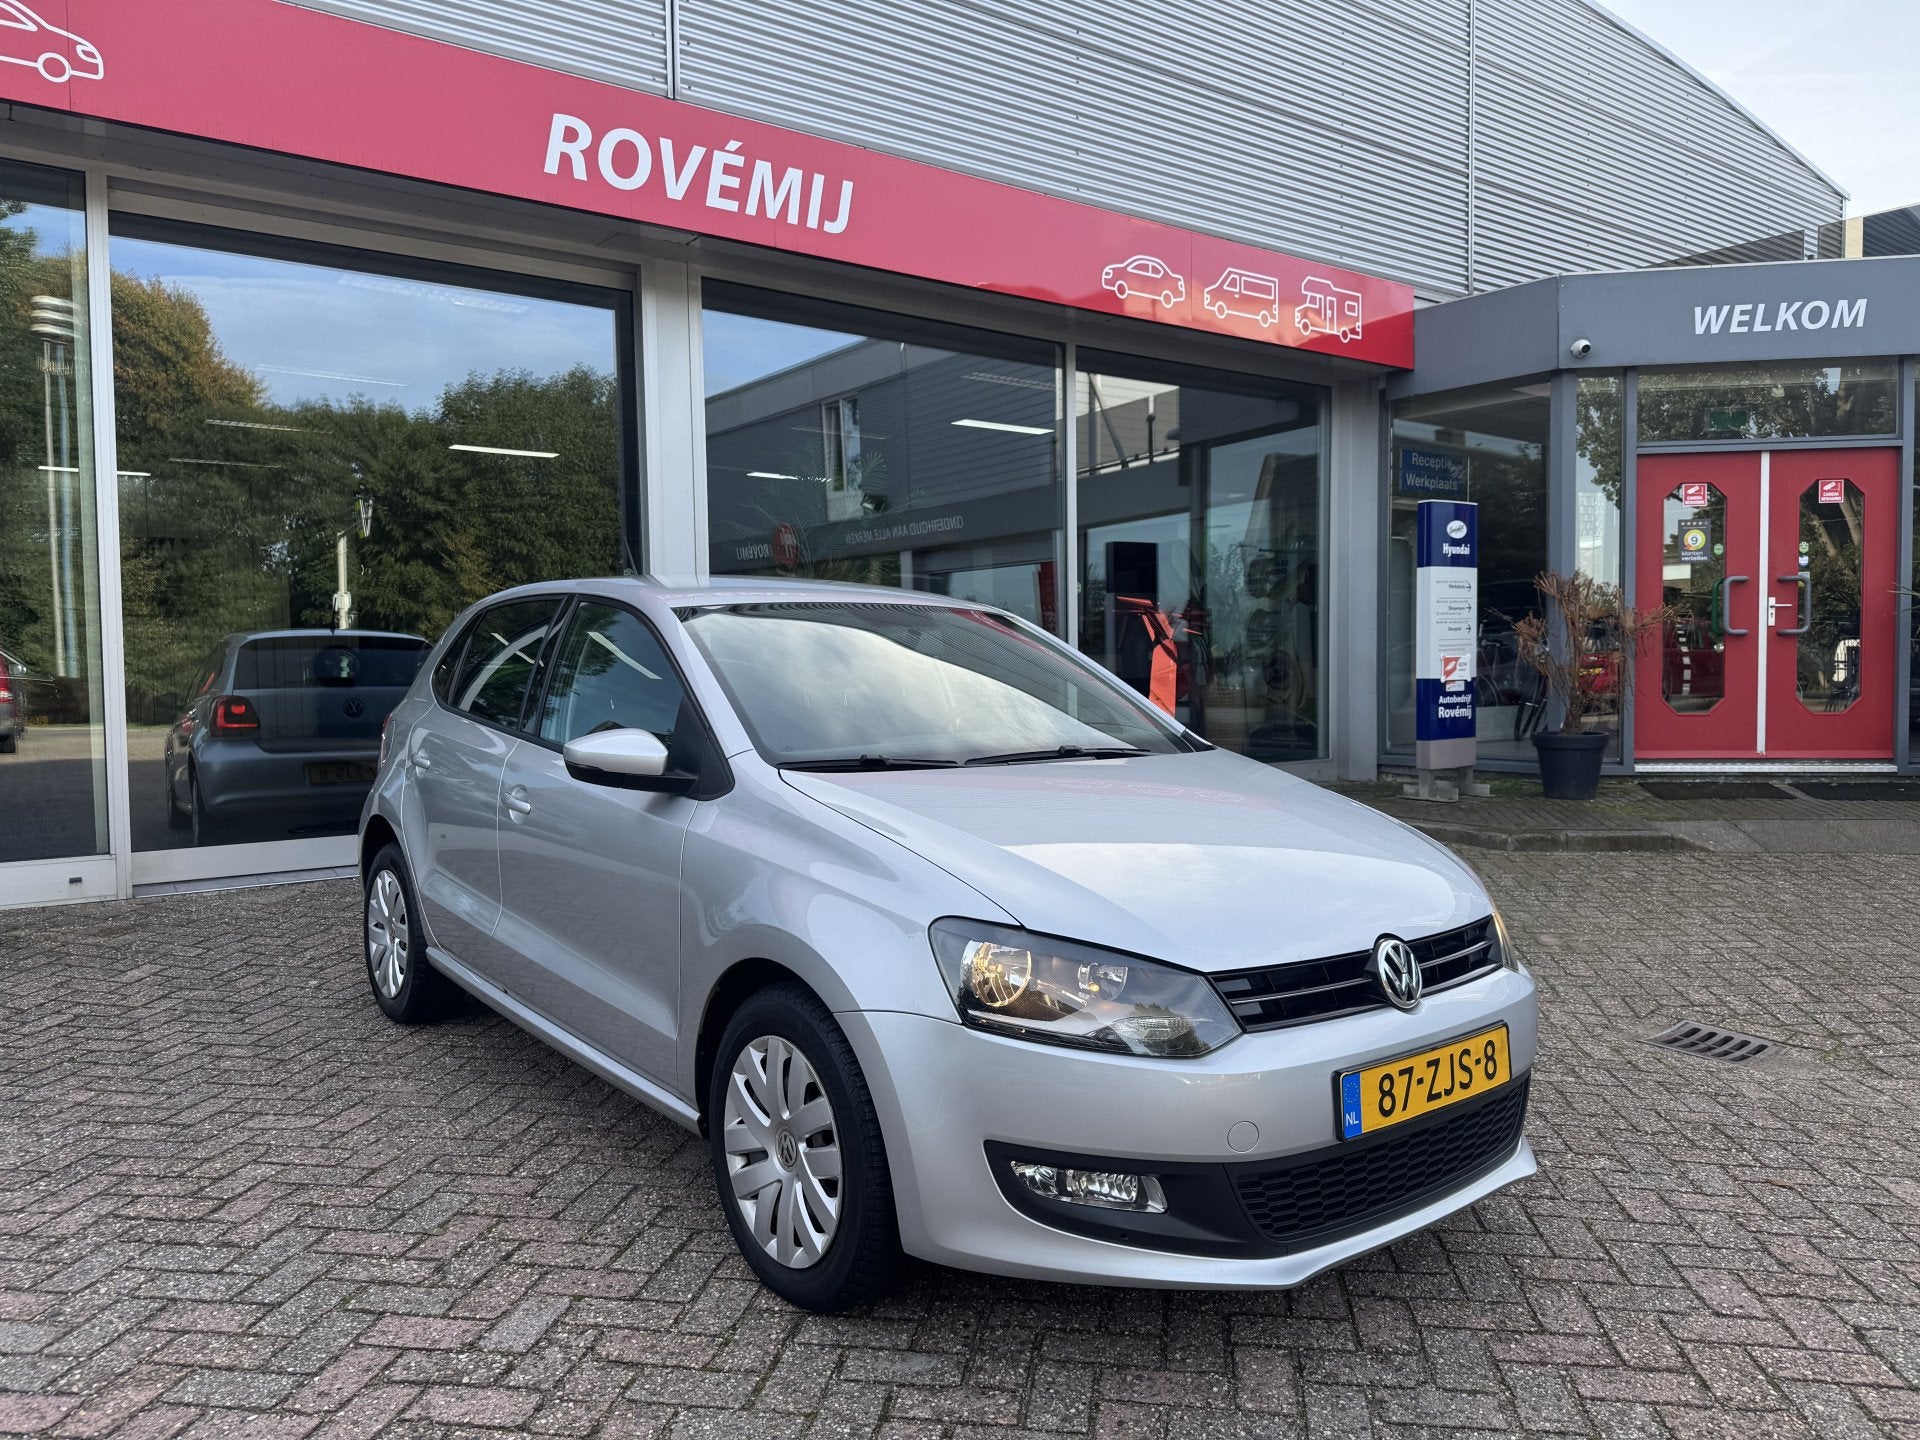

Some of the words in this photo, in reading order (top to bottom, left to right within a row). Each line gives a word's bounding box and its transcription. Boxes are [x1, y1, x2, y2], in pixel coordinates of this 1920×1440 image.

[544, 113, 853, 234] ROVÉMIJ
[1694, 298, 1868, 335] WELKOM
[1412, 452, 1454, 471] Receptie
[1405, 472, 1458, 491] Werkplaats
[1442, 543, 1470, 557] Hyundai
[1438, 694, 1472, 704] Autobedrijf
[1438, 704, 1472, 720] Rovémij
[1378, 1039, 1498, 1118] 87-ZJS-8
[1345, 1111, 1359, 1127] NL
